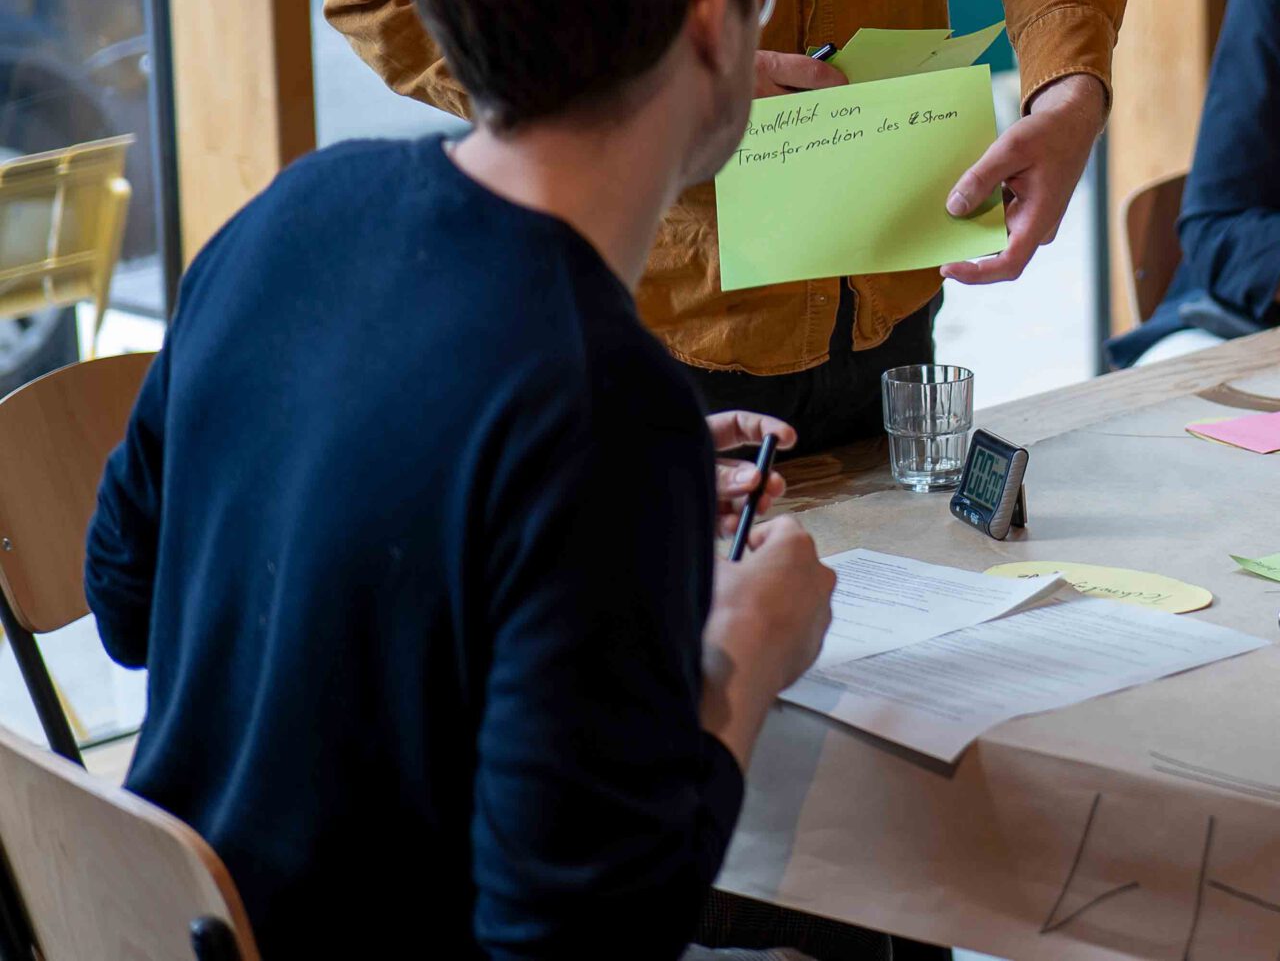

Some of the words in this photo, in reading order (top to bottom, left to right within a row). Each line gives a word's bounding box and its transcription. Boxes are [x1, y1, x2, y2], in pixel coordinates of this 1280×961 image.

[830, 105, 862, 119] von
[734, 128, 864, 165] Transformation
[877, 117, 900, 133] des
[921, 109, 958, 124] Strom
